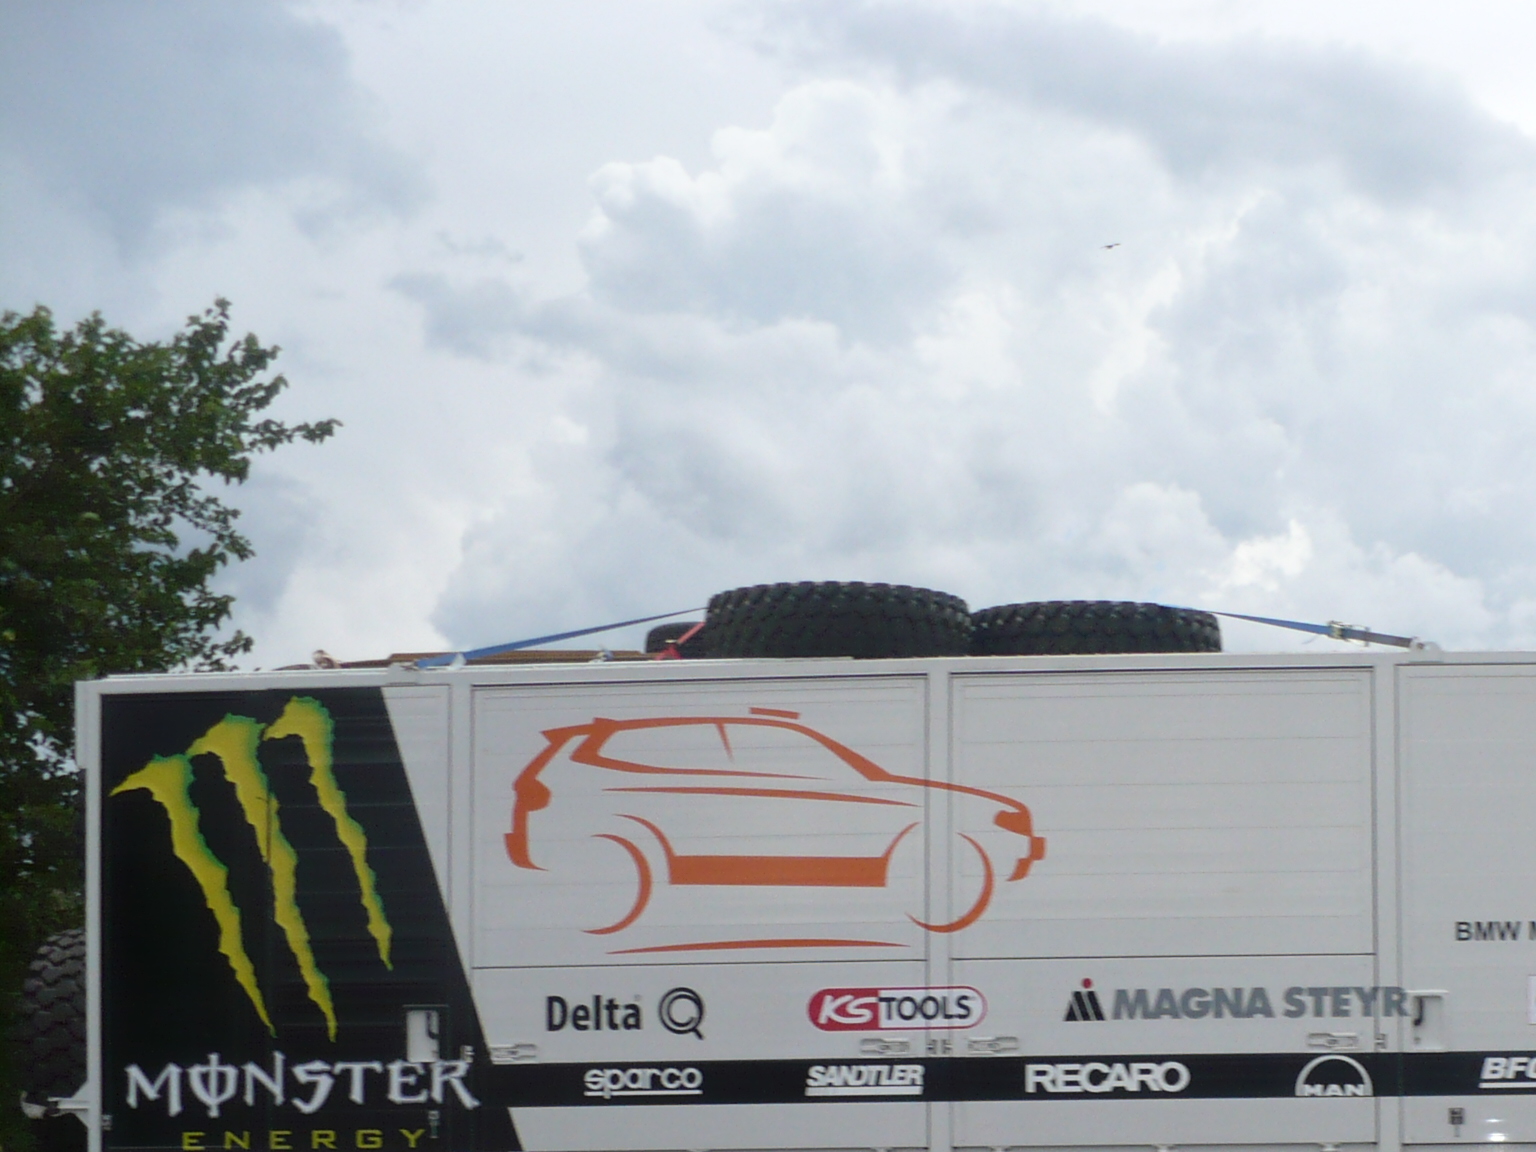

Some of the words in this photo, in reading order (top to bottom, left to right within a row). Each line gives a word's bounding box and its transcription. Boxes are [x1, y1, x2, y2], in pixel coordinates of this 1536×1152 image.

[1454, 921, 1520, 942] BMW
[547, 996, 642, 1031] Delta
[817, 994, 873, 1024] KS
[877, 995, 972, 1021] TOOLS
[1112, 988, 1275, 1020] MAGNA
[1283, 986, 1412, 1018] STEYR
[124, 1050, 480, 1118] MONSTER
[584, 1067, 702, 1098] sparco
[806, 1064, 925, 1087] SANDTLER
[1025, 1061, 1191, 1093] RECARO
[1301, 1083, 1366, 1097] MAN
[182, 1128, 425, 1151] ENERGY
